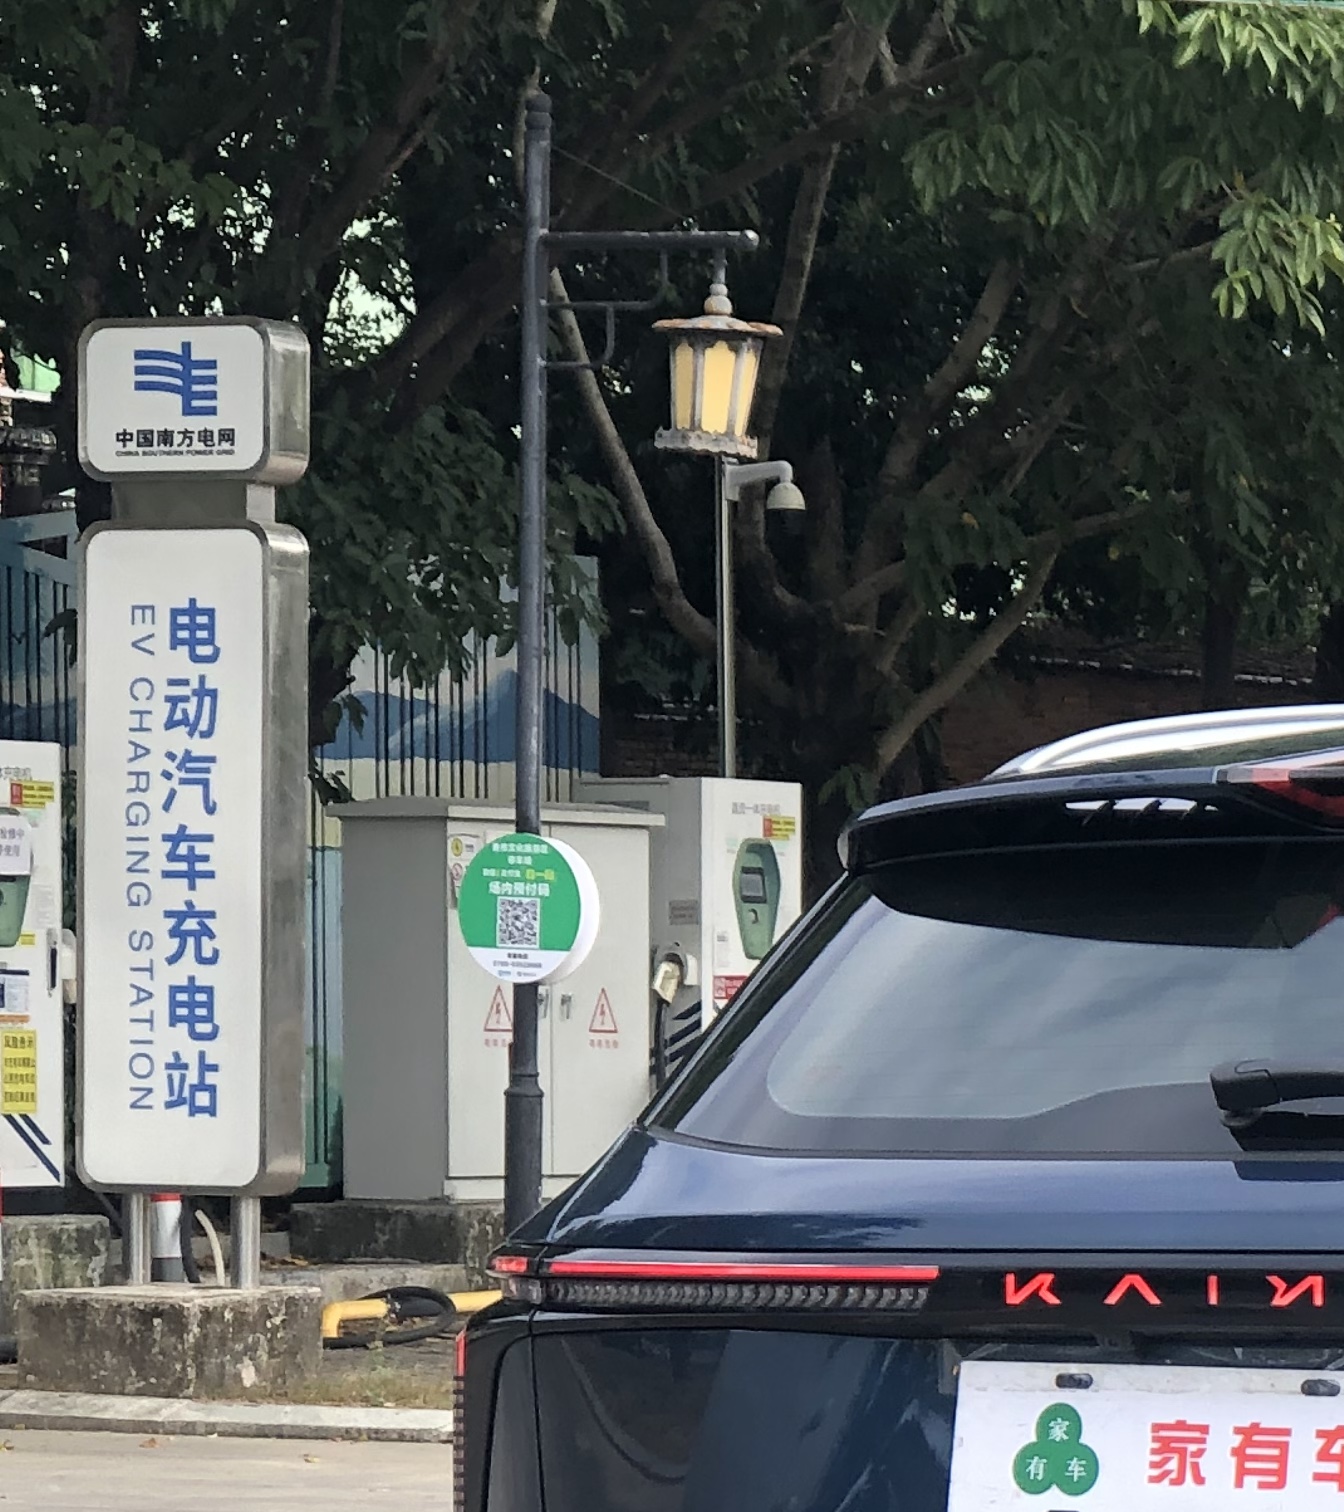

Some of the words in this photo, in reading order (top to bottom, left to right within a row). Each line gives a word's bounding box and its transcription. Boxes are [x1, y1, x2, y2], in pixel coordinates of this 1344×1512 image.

[115, 427, 236, 448] 中国南方电网
[130, 604, 156, 657] EV
[125, 676, 155, 907] CHARGING
[160, 597, 221, 1118] 电动汽车充电站
[128, 929, 155, 1111] STATION
